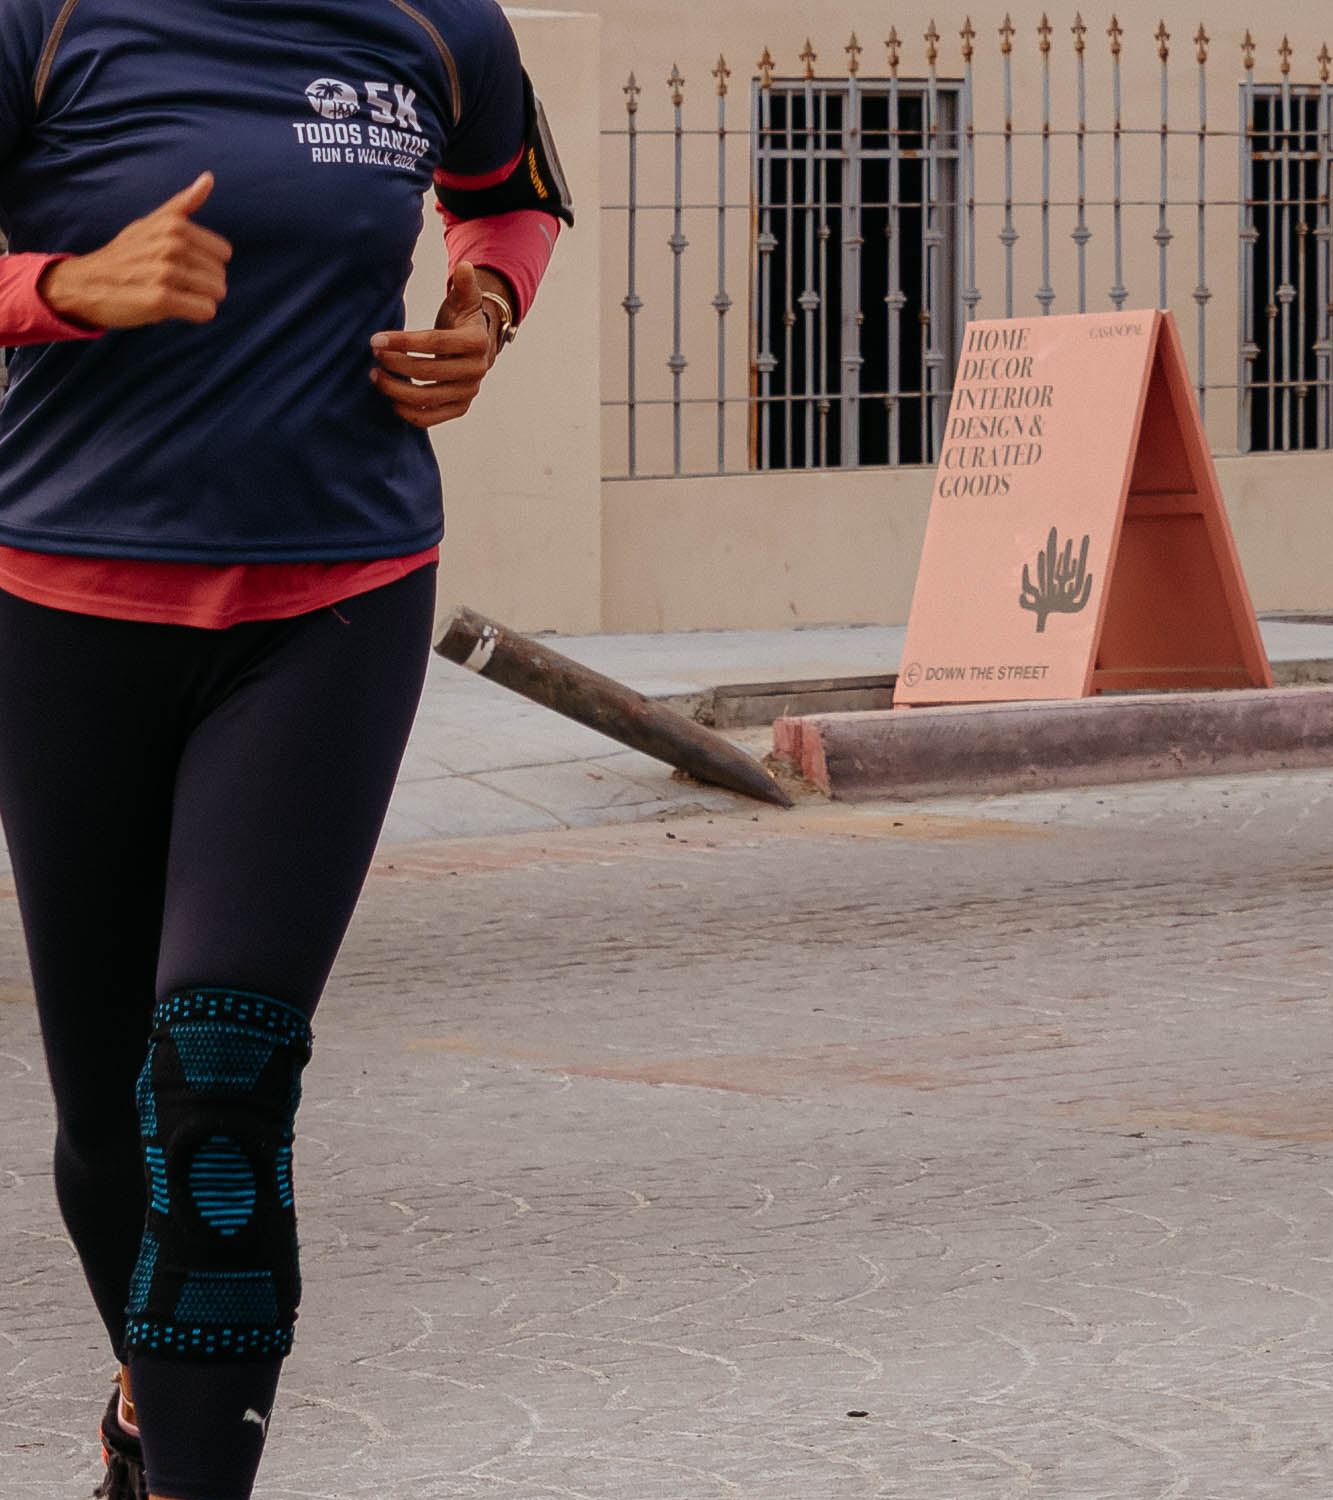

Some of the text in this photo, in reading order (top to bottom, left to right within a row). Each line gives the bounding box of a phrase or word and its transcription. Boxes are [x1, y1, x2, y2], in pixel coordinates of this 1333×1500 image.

[364, 81, 422, 132] 5K
[293, 122, 430, 158] TODOS SANTOS
[312, 147, 341, 163] RUN
[345, 148, 355, 163] &
[358, 148, 392, 166] WALK
[968, 328, 1030, 352] HOME
[962, 356, 1033, 381] DECOR
[955, 385, 1054, 410] INTERIOR
[950, 414, 1044, 439] DESIGN &
[944, 444, 1042, 470] CURATED
[938, 474, 1012, 498] GOODS
[925, 665, 1049, 680] DOWN THE STREET
